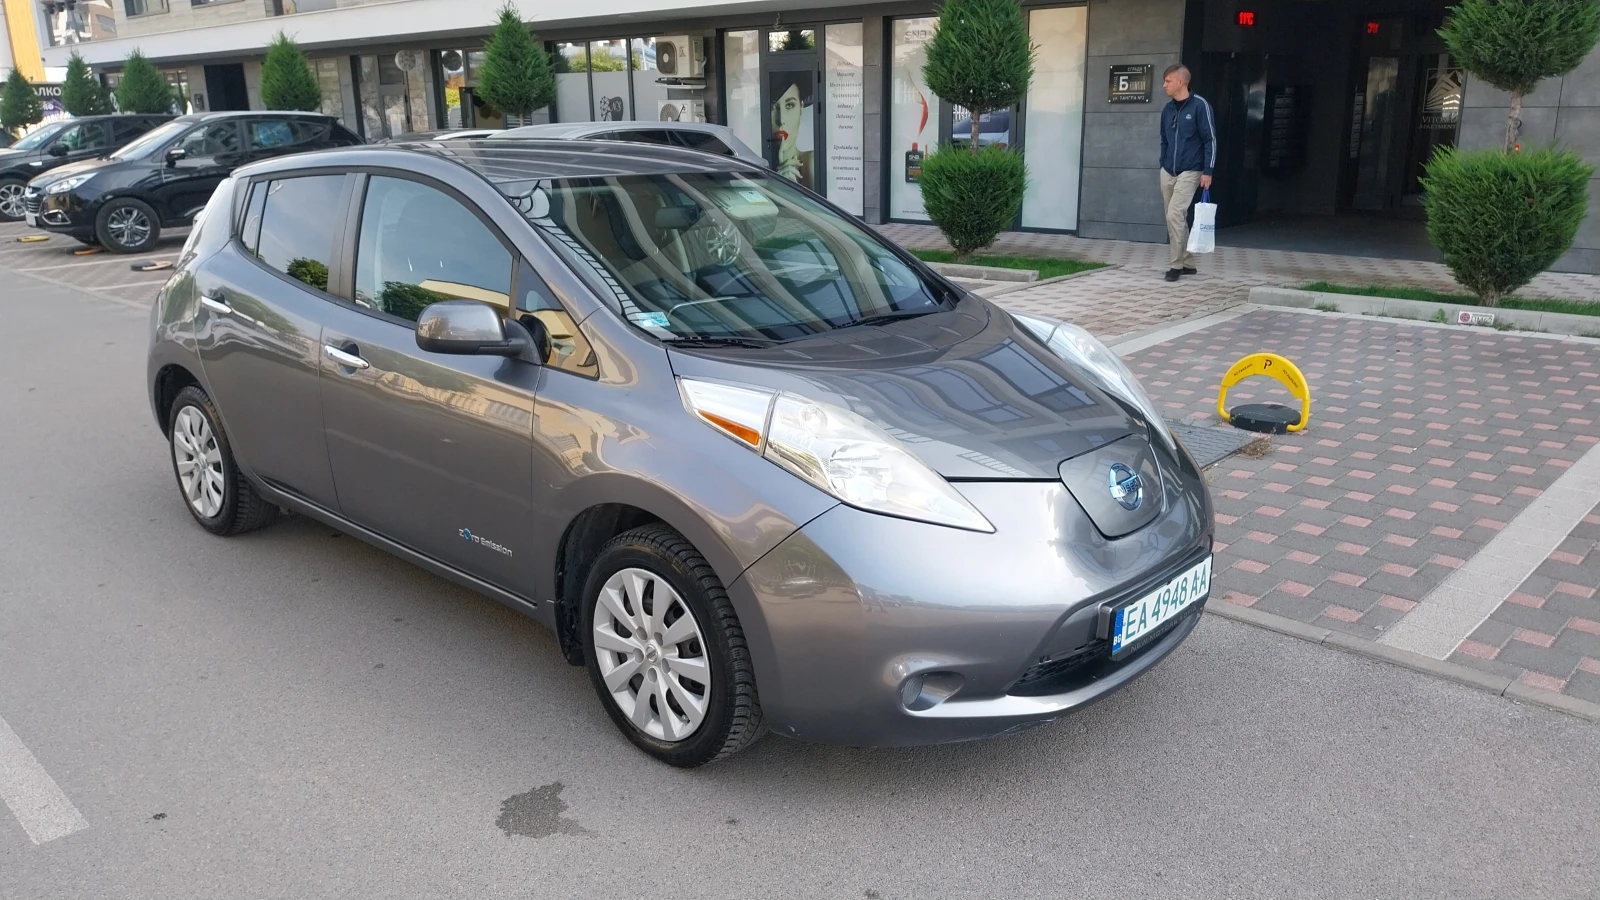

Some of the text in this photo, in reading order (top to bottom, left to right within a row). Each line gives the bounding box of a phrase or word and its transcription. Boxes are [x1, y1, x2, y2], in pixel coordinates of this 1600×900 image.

[1119, 76, 1128, 90] Б
[1264, 359, 1272, 369] P
[1152, 577, 1188, 622] 4948
[1113, 633, 1123, 646] BG
